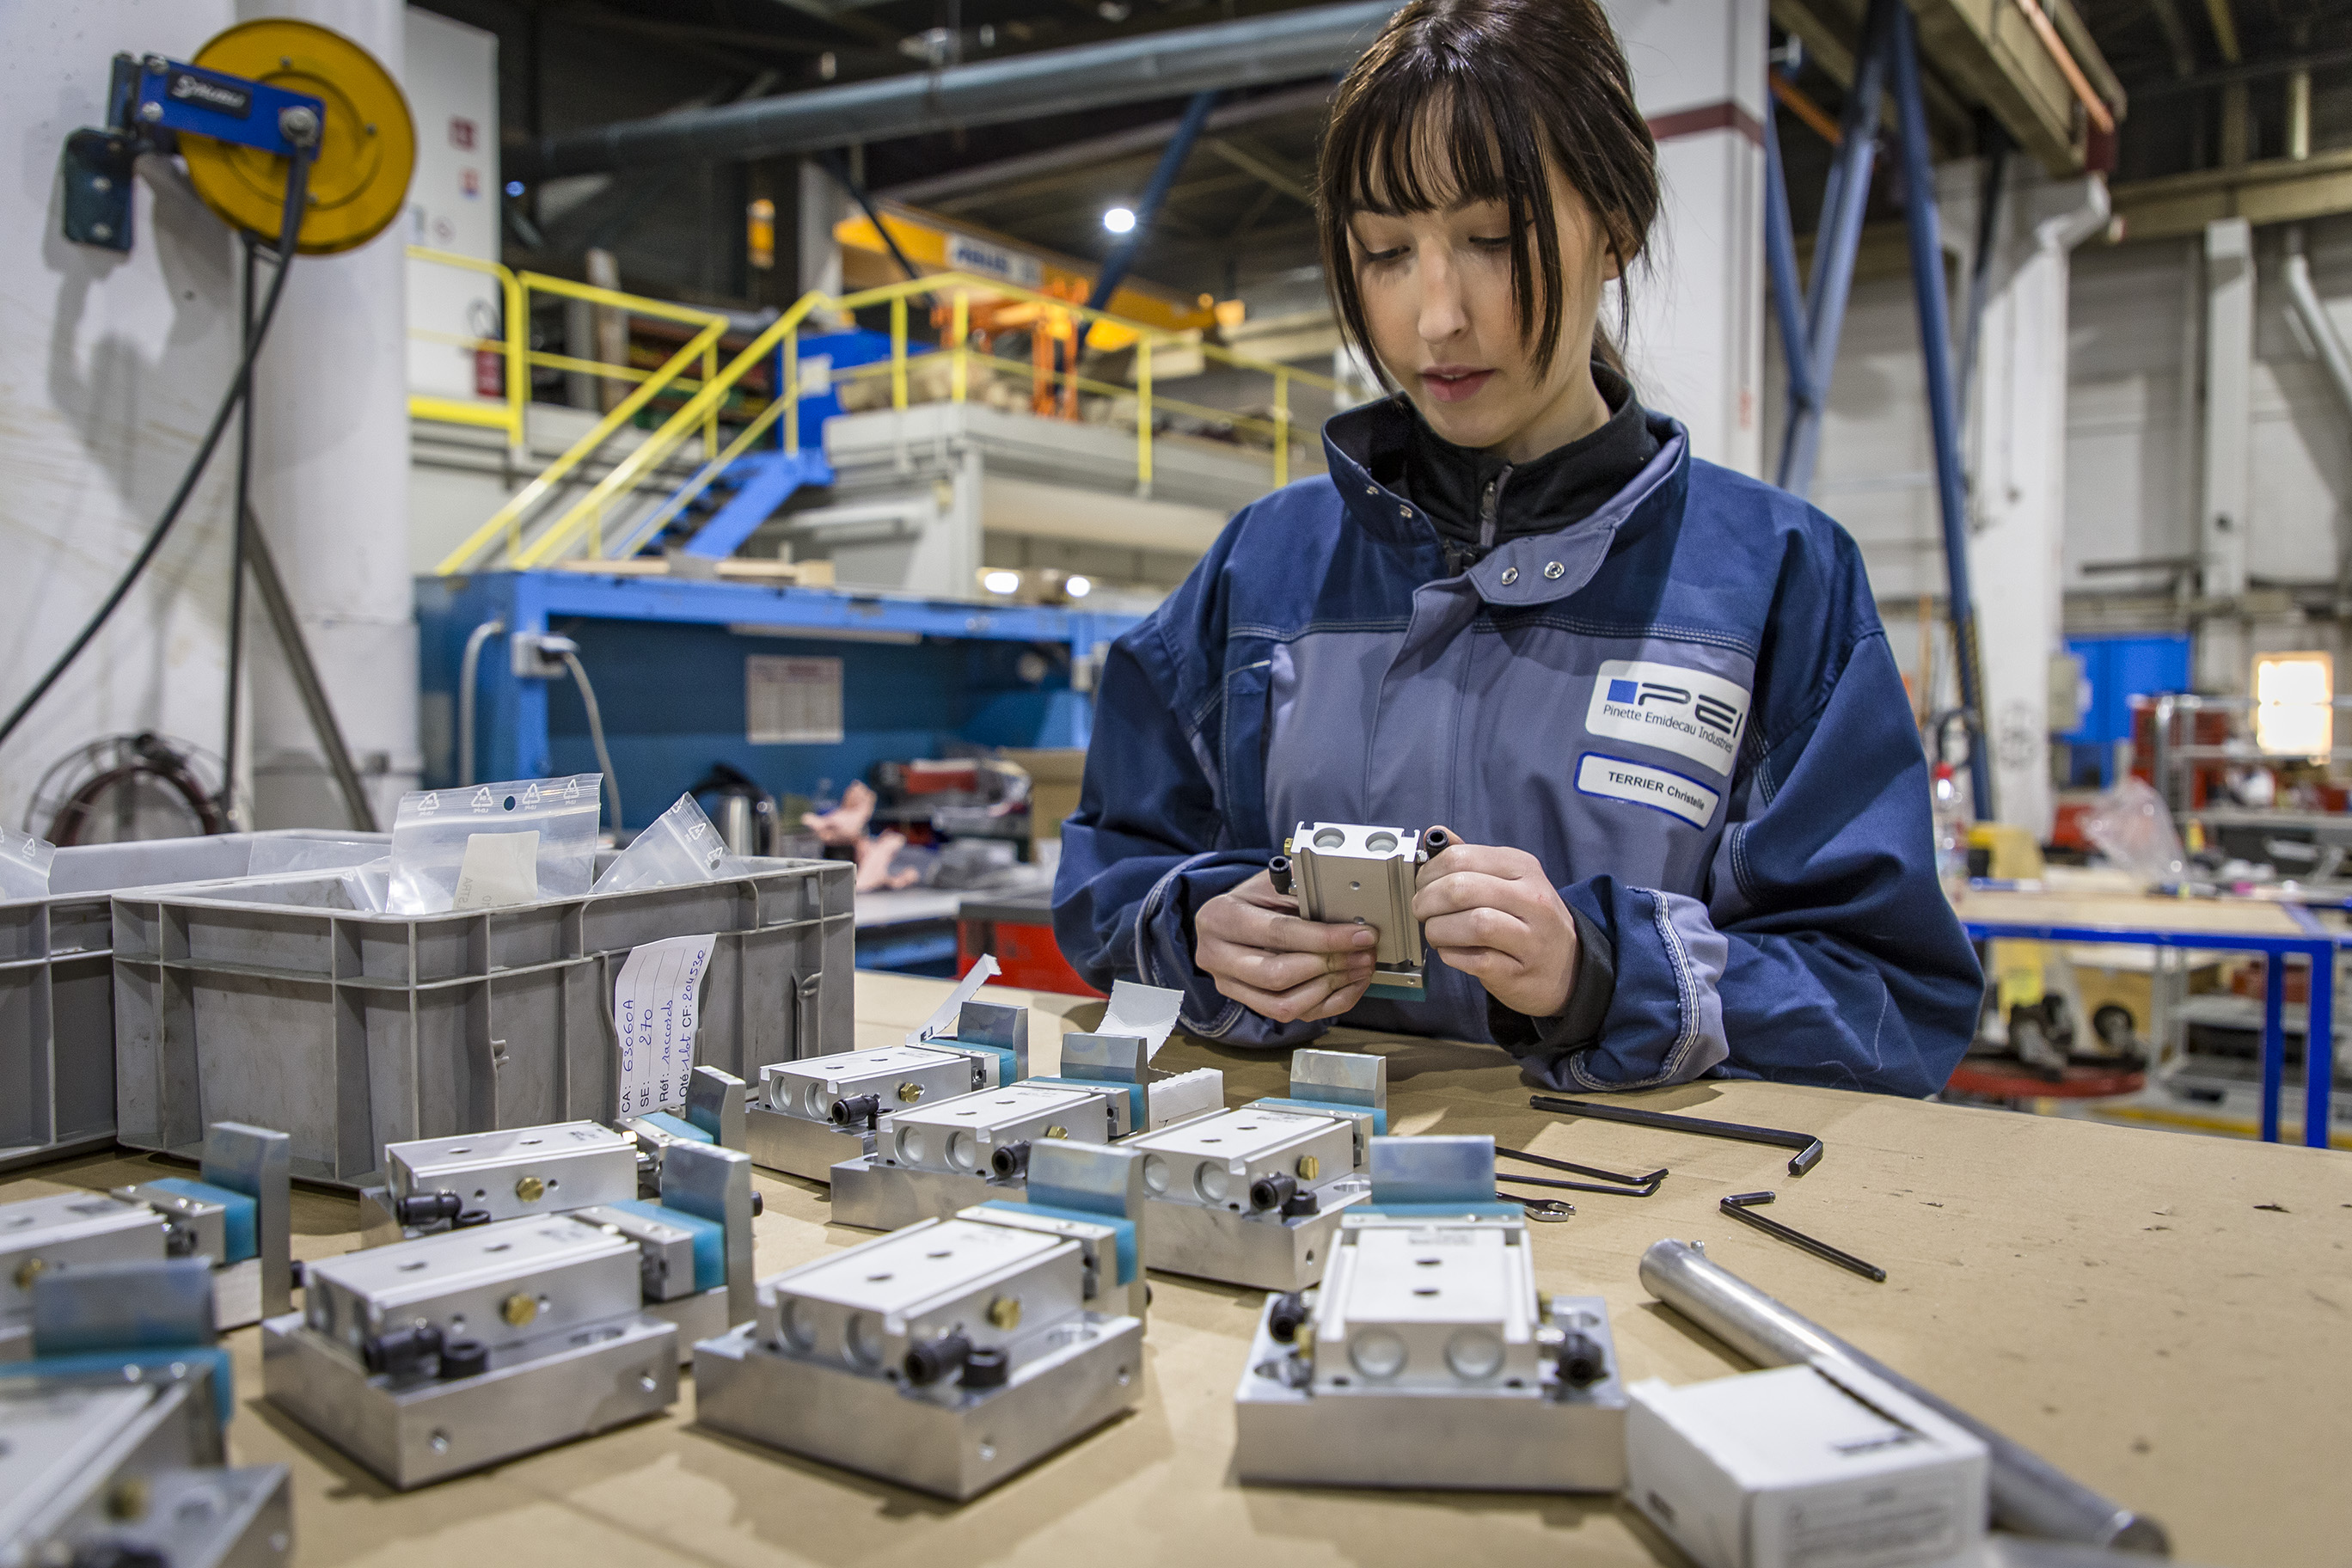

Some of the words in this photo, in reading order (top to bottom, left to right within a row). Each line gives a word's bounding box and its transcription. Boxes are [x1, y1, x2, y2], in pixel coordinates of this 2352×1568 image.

[1602, 704, 1642, 721] Pinette
[1645, 711, 1697, 735] Emidecau
[1699, 726, 1733, 753] Industries
[1638, 683, 1743, 738] PEI
[1608, 771, 1664, 793] TERRIER
[1667, 785, 1706, 812] Christelle
[682, 950, 704, 1001] 204530
[622, 1000, 634, 1072] 63060A
[639, 1008, 653, 1046] 270
